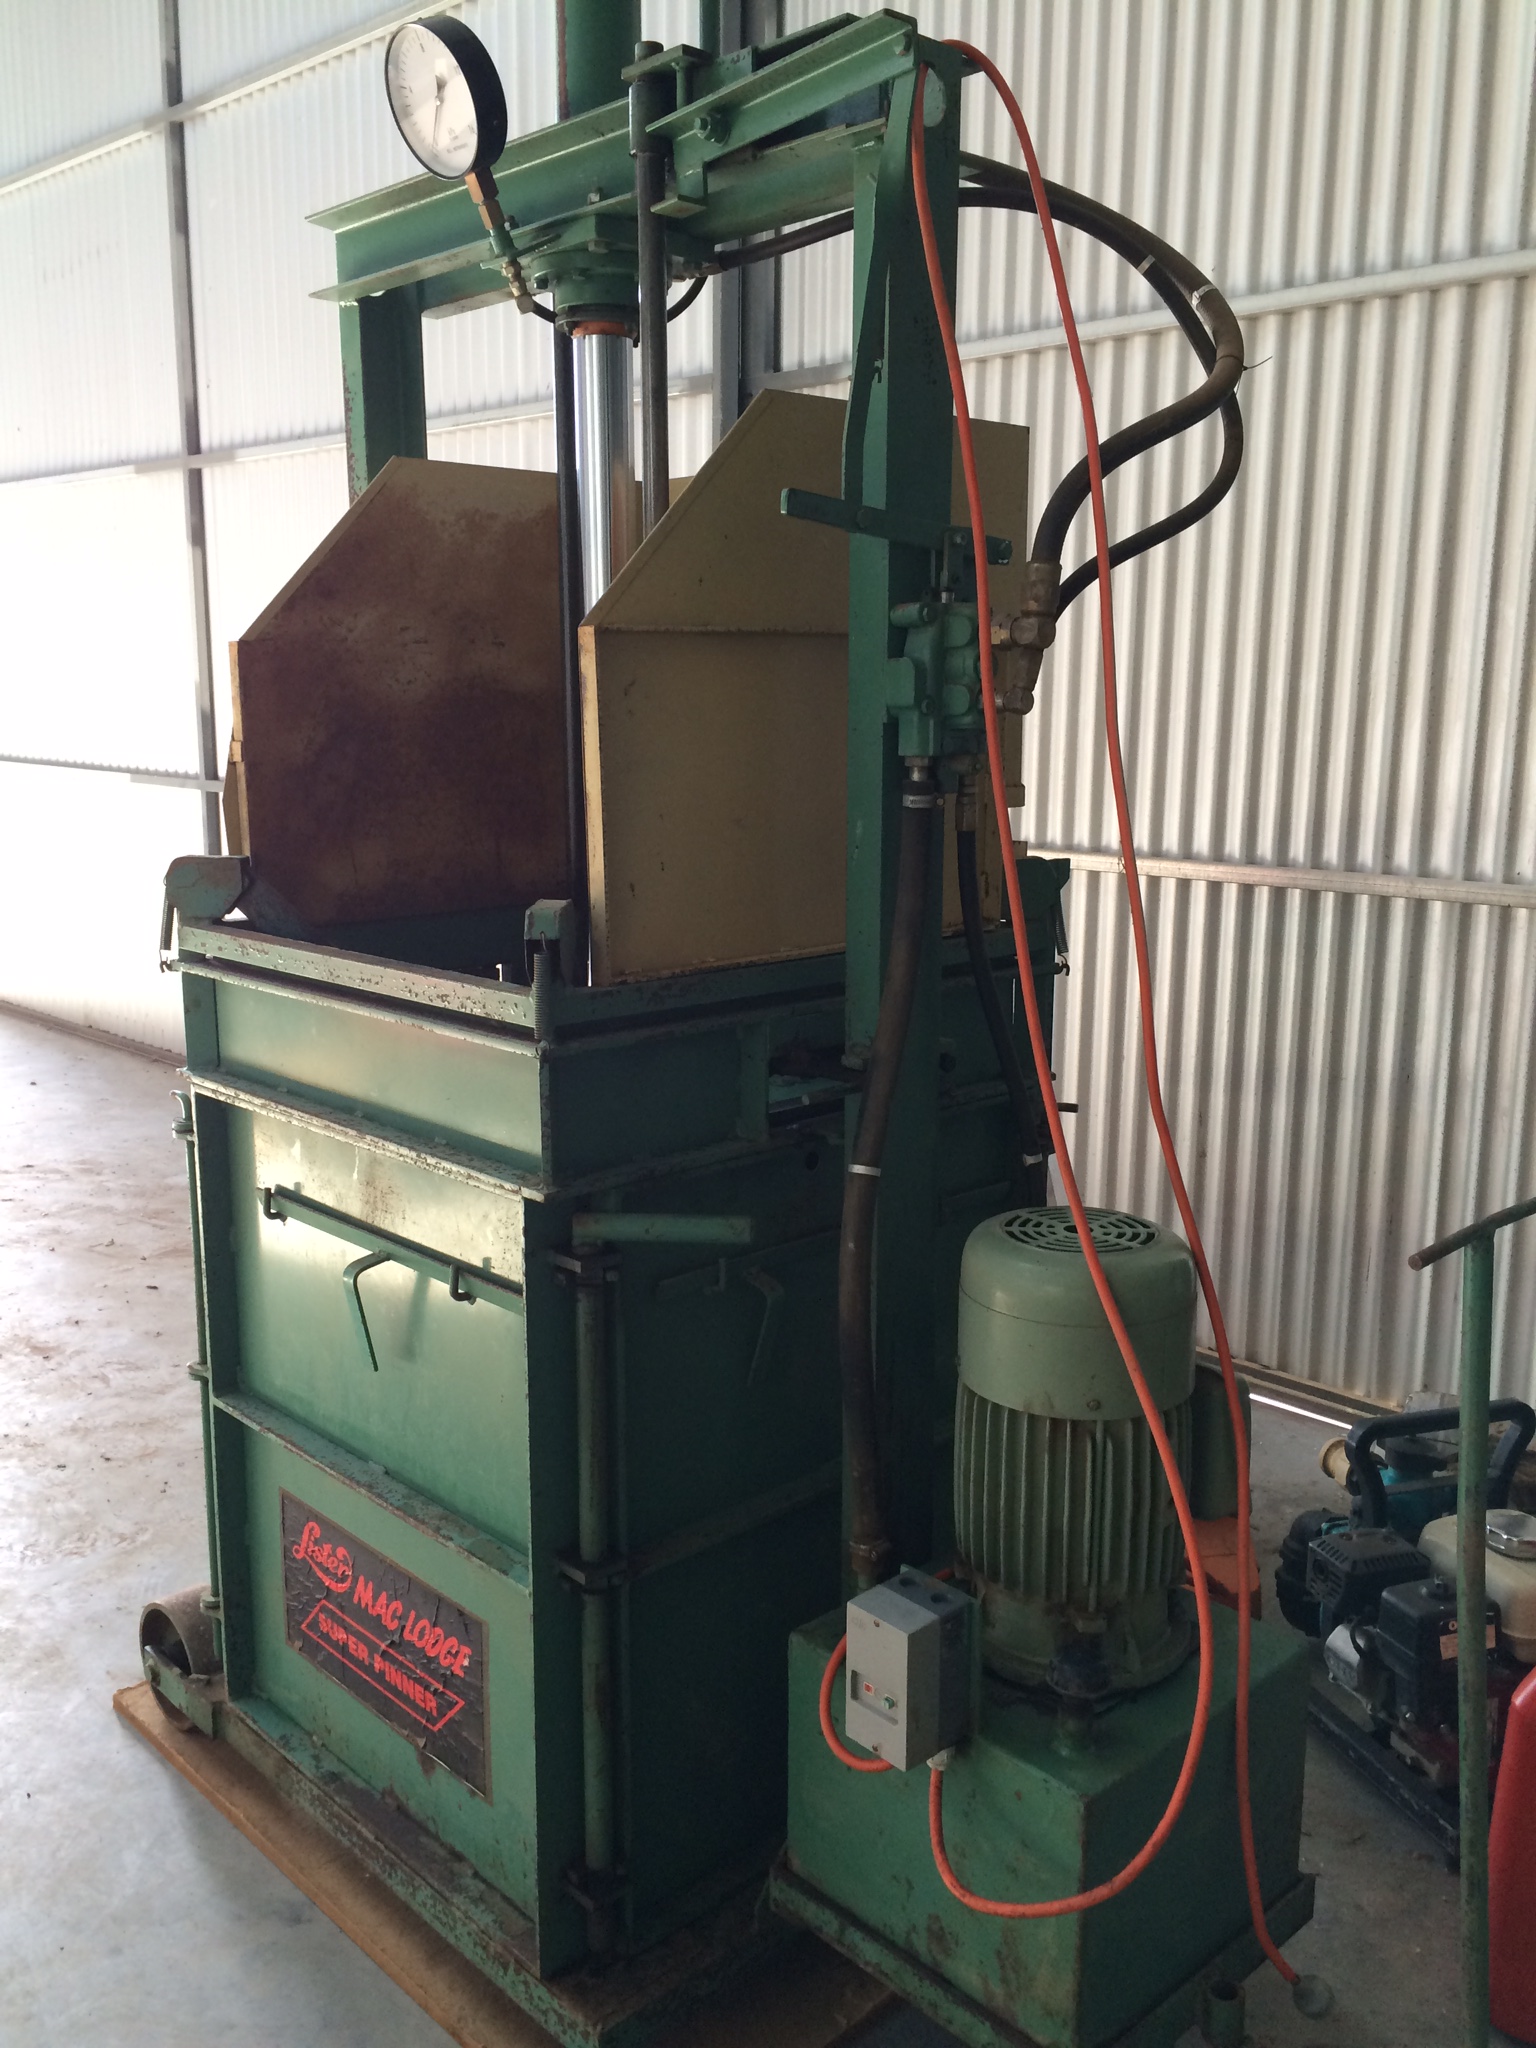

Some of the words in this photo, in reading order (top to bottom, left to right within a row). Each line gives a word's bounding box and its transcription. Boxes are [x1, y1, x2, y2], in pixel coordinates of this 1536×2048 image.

[292, 1521, 353, 1593] Lister
[318, 1611, 369, 1666] SUPER
[373, 1653, 438, 1716] PINNER
[353, 1575, 404, 1631] MAC
[403, 1609, 472, 1677] LODGE
